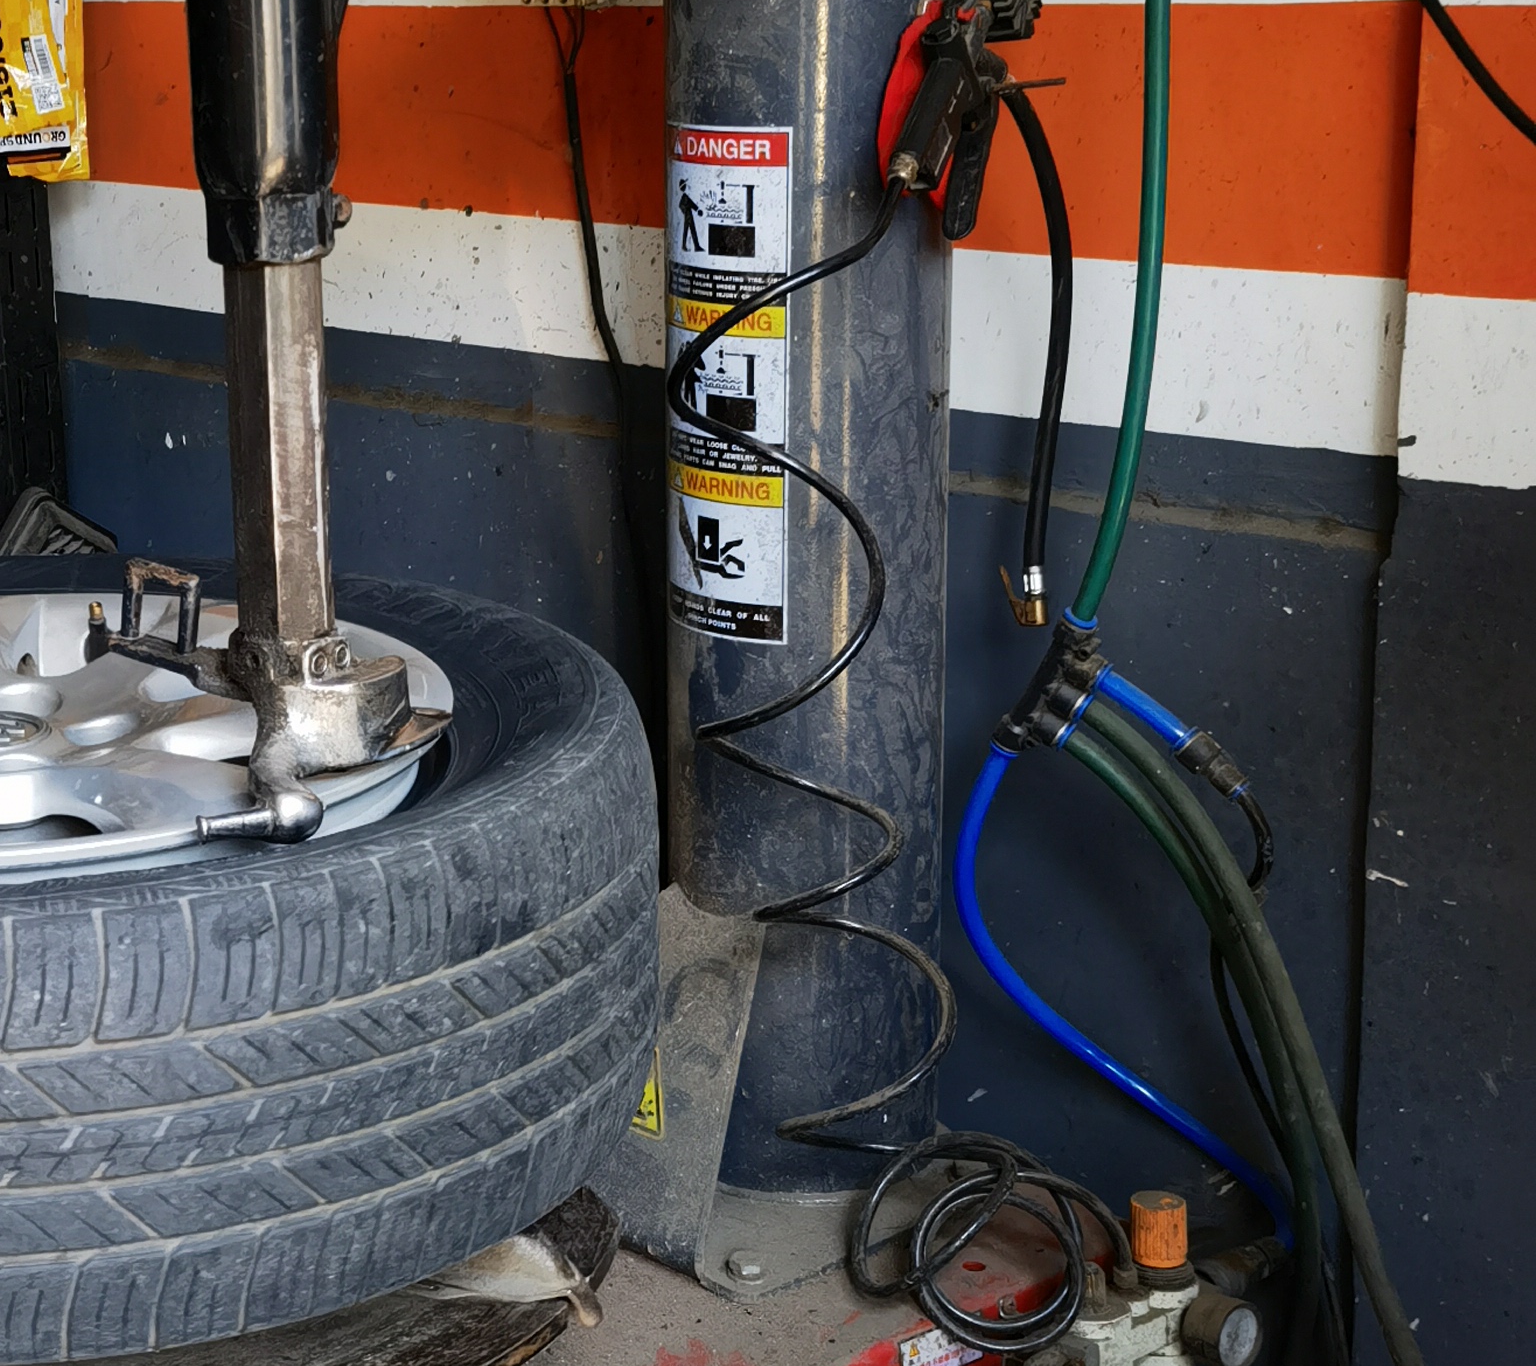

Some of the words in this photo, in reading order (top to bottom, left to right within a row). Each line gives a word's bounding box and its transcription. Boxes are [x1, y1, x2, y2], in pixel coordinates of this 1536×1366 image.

[686, 136, 771, 161] DANGER
[686, 304, 772, 332] WARNG
[685, 470, 771, 501] WARNING
[707, 605, 733, 618] CLEAR
[753, 613, 771, 623] ALL
[708, 618, 737, 631] POINTS
